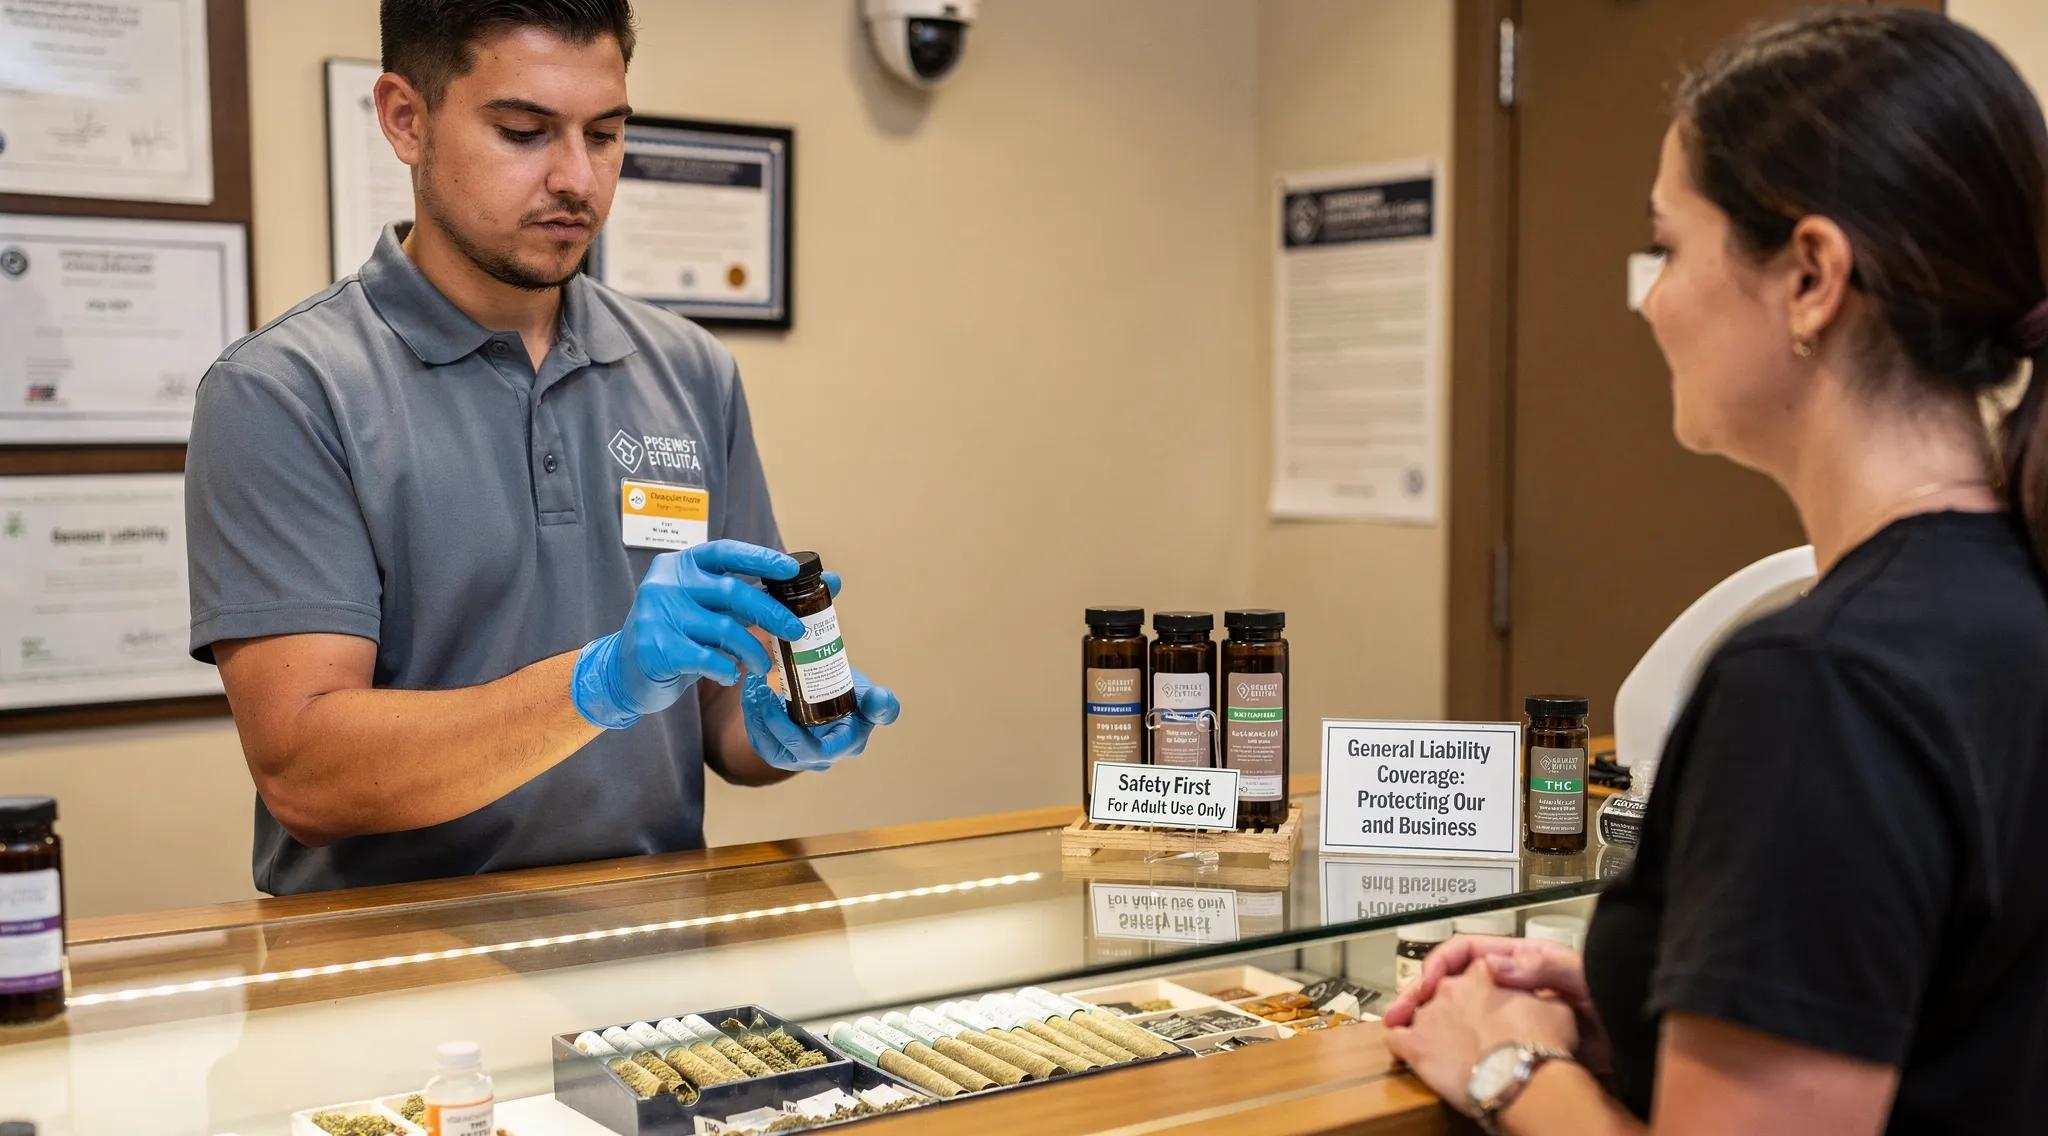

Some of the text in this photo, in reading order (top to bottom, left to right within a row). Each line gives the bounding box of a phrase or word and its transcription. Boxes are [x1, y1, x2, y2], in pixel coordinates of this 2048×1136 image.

[816, 642, 838, 659] THC
[1347, 739, 1491, 764] General Liability
[1118, 773, 1211, 797] Safety First
[1377, 765, 1465, 789] Coverage:
[1544, 780, 1572, 791] THC
[1107, 797, 1227, 820] For Adult Use Only
[1357, 790, 1486, 815] Protecting Our
[1361, 816, 1477, 836] and Business
